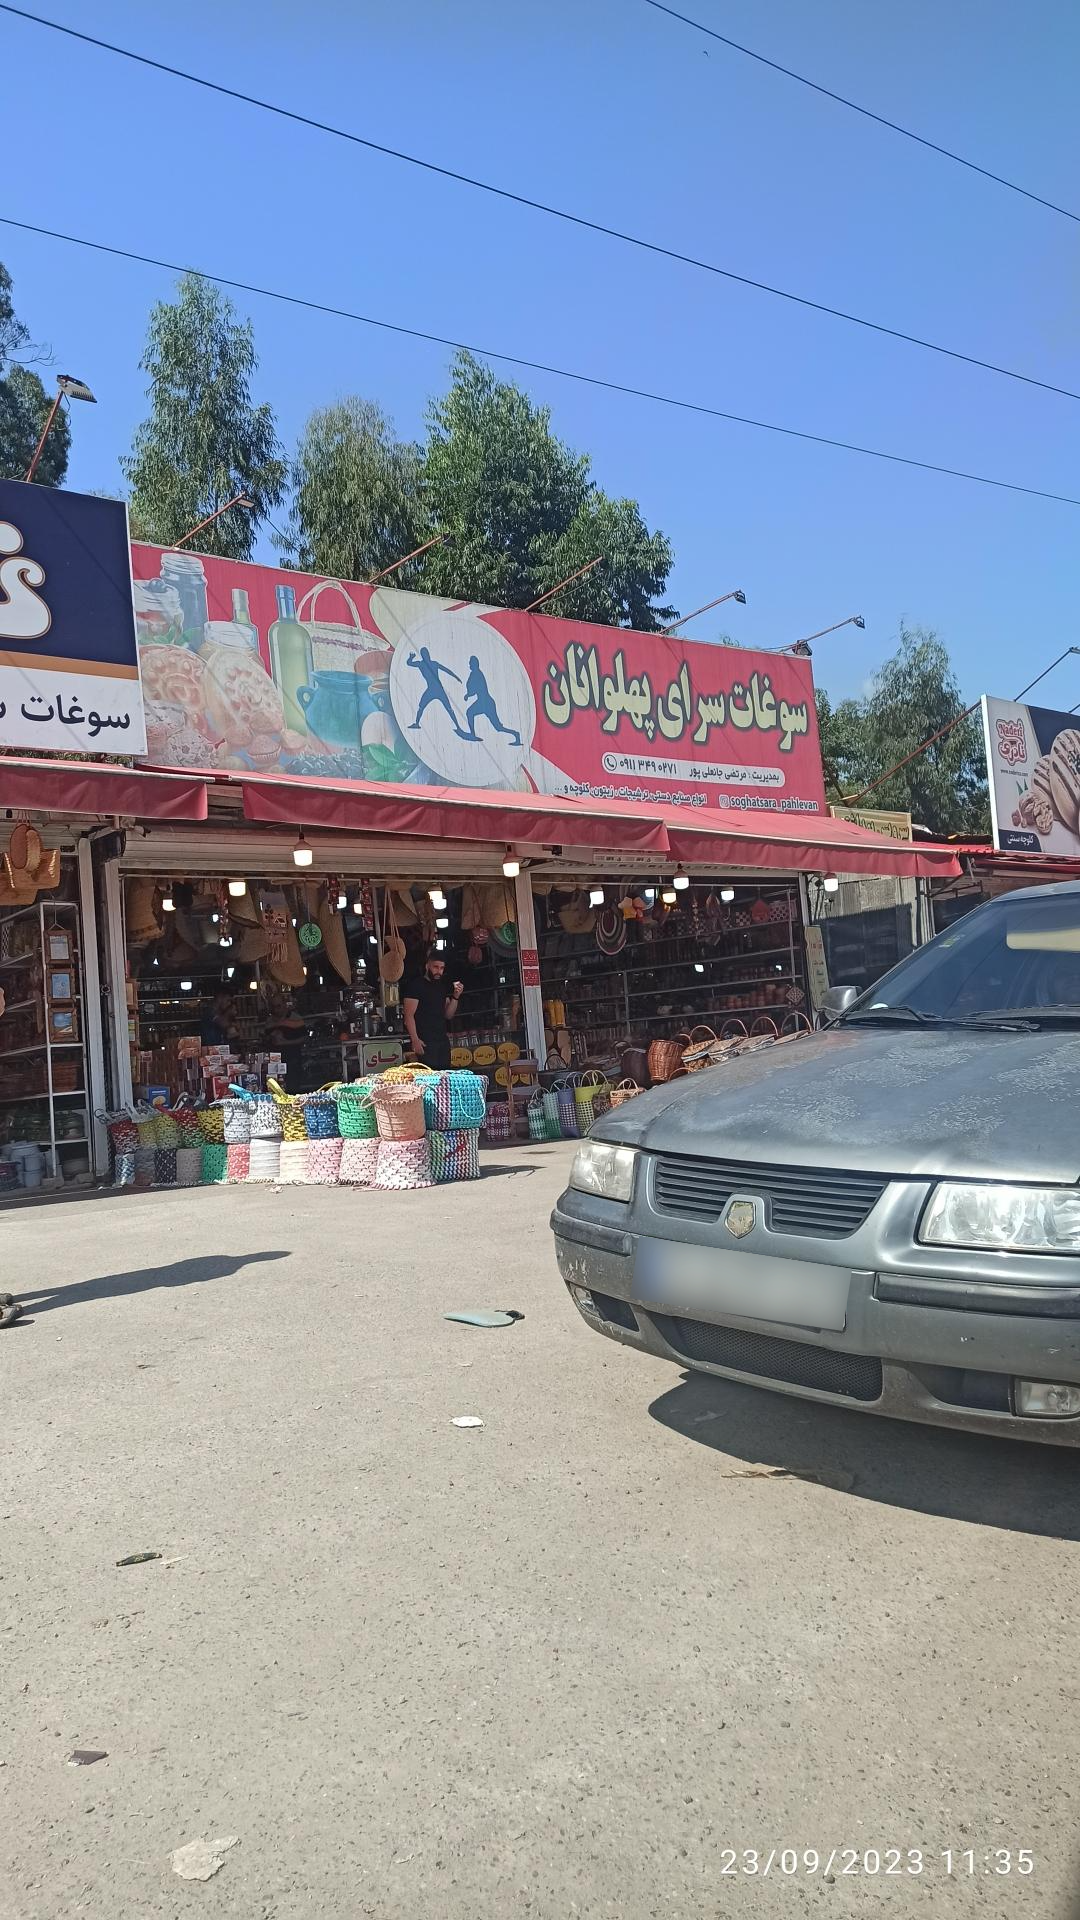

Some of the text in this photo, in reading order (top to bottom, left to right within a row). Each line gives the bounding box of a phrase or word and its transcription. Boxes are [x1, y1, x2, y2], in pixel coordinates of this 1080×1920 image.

[544, 643, 808, 750] سوغات سرای پهلوانان
[20, 693, 131, 738] سوغات
[998, 719, 1024, 737] Naderi
[1000, 740, 1026, 762] نادری
[620, 758, 636, 770] ۰۹۱۱
[689, 767, 701, 779] پور
[701, 766, 723, 779] جانعلی
[724, 767, 747, 781] مرتضی
[564, 784, 569, 794] و
[569, 783, 590, 796] کلوچه
[672, 791, 691, 805] صنایع
[692, 793, 707, 807] انواع
[730, 794, 818, 811] soghatsara_pahlevan
[1007, 834, 1034, 846] کلوچه سنتی
